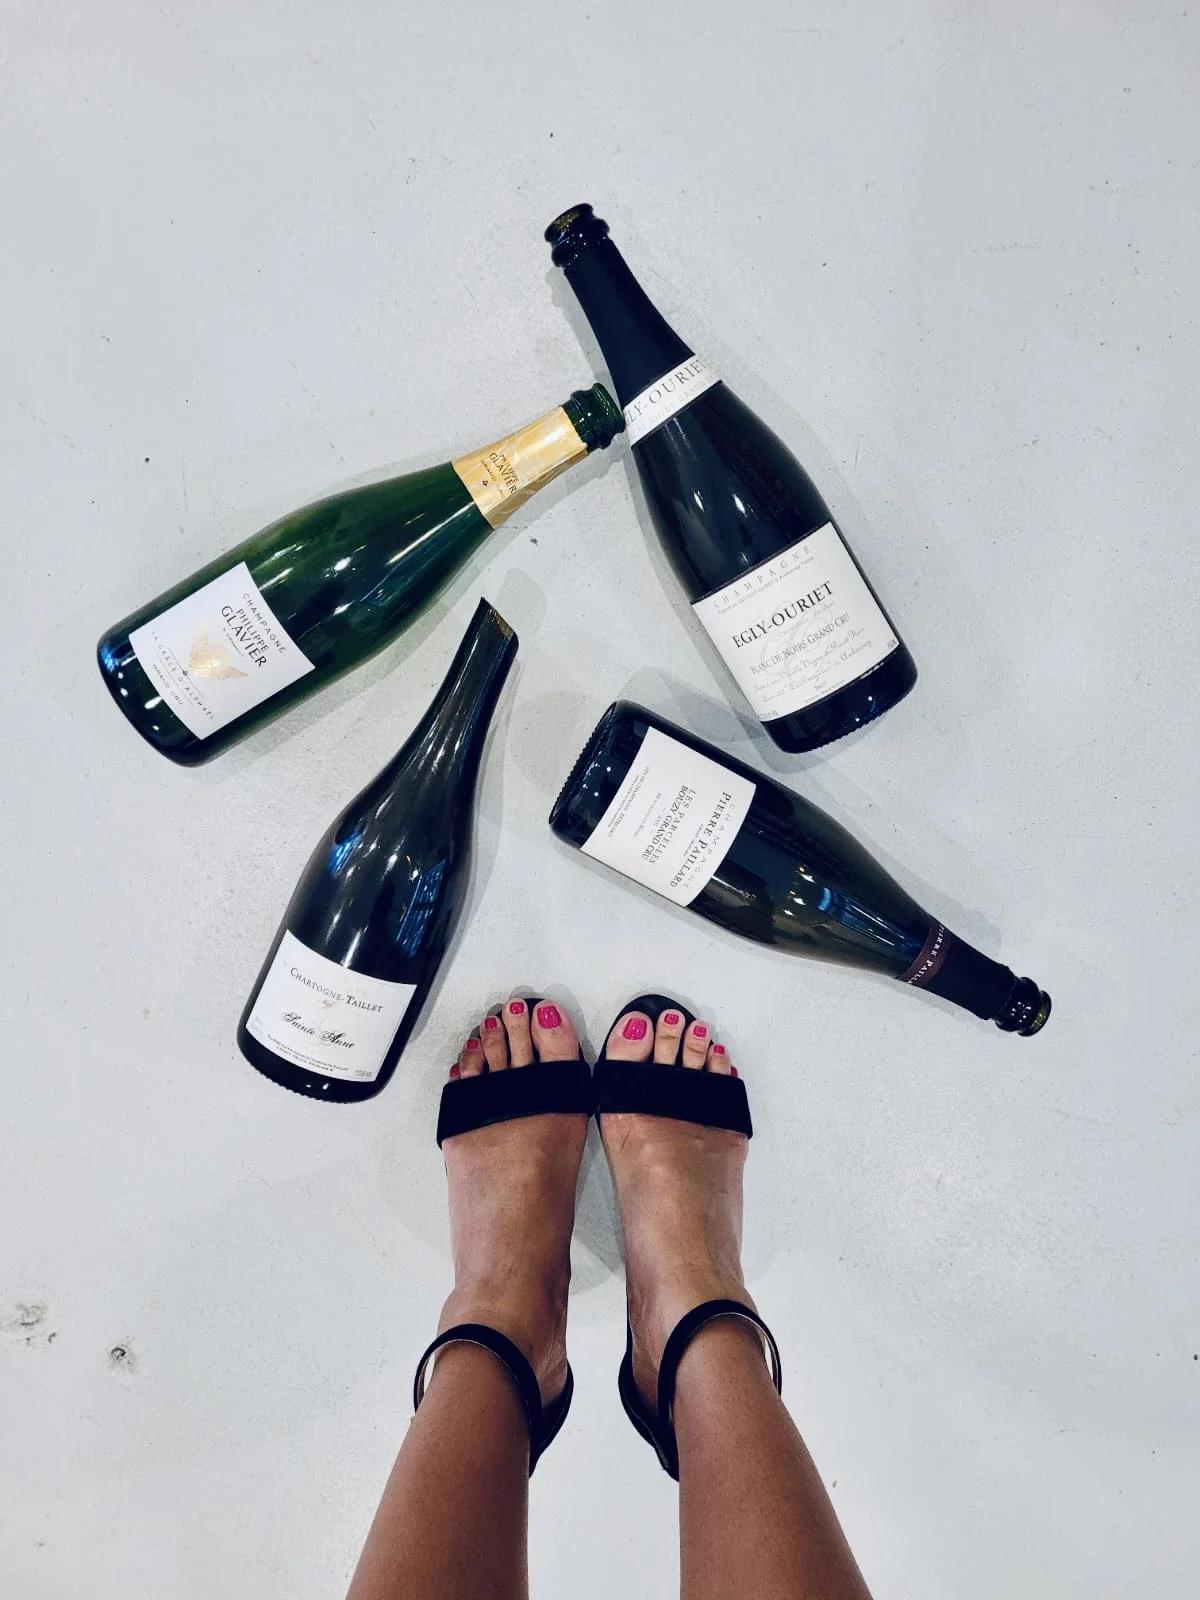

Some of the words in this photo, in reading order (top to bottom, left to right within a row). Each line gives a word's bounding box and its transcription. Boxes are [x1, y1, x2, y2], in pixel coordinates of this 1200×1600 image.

[488, 452, 517, 493] GLAVIER
[712, 544, 811, 608] CHAMPAGNE
[150, 630, 159, 641] LA
[218, 604, 267, 668] GLAVIER
[235, 608, 269, 653] PHILIPPE
[241, 592, 286, 654] CHAMPAGNE
[732, 580, 834, 649] EGLY-OURIET
[749, 658, 772, 675] BLANC
[770, 652, 783, 665] DE
[781, 638, 808, 659] NOIRS
[805, 622, 835, 645] GRAND
[833, 612, 850, 627] CRU
[151, 663, 171, 689] GRAND
[169, 690, 183, 706] CRU
[668, 784, 689, 814] BOUZY
[681, 788, 696, 808] LES
[702, 790, 731, 837] PIERRE
[640, 843, 655, 861] CRU
[648, 811, 684, 865] PARCELLES
[650, 813, 673, 846] GRAND
[681, 802, 736, 889] CHAMPAGNE
[668, 838, 708, 889] PAILLARD
[279, 1009, 317, 1037] Sainte
[317, 1028, 355, 1050] Anne
